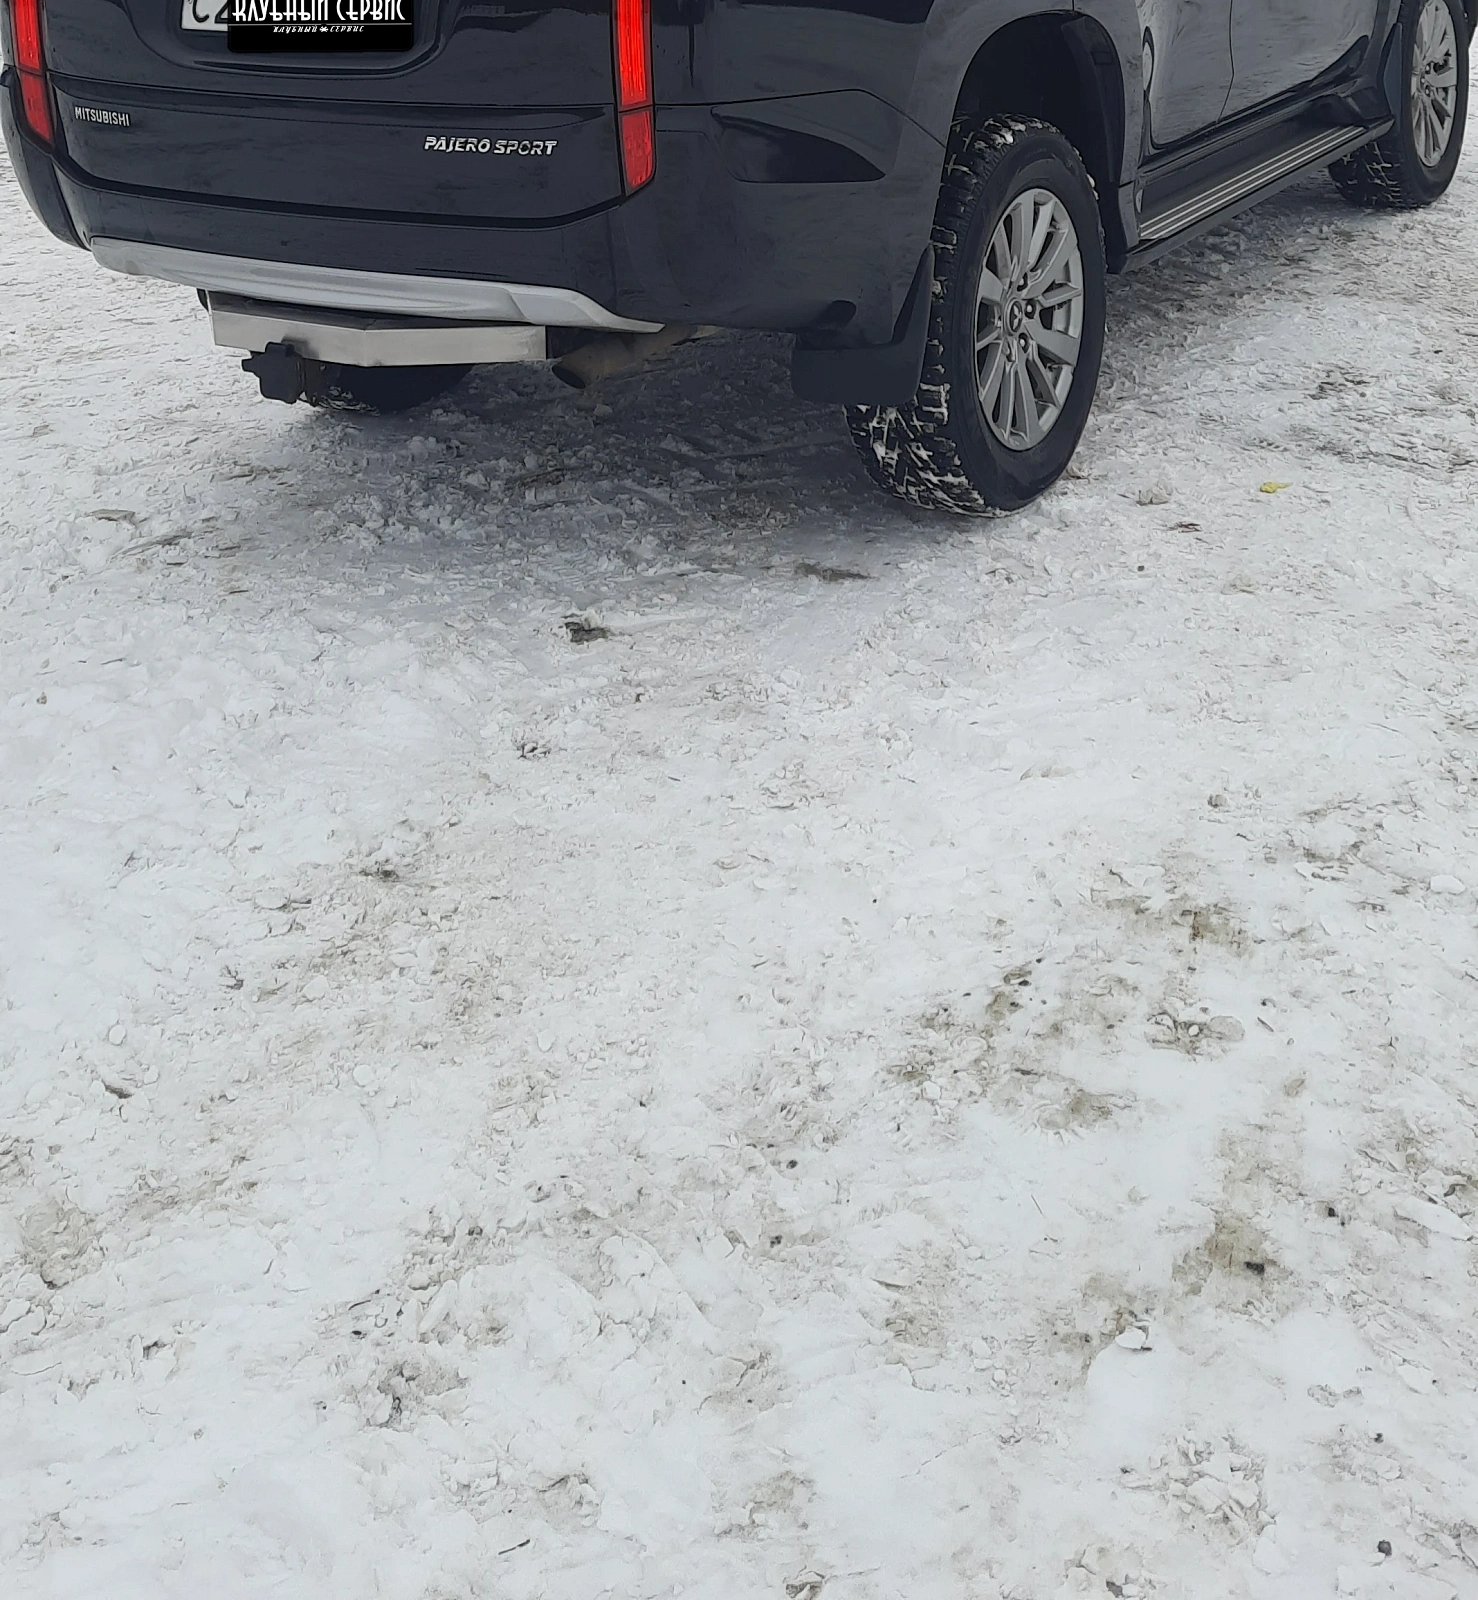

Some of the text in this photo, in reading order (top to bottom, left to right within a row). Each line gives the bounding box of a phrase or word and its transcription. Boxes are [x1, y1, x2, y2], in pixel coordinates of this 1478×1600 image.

[74, 106, 130, 127] MITSUBISHI
[424, 136, 558, 155] PAJERO SPORT
